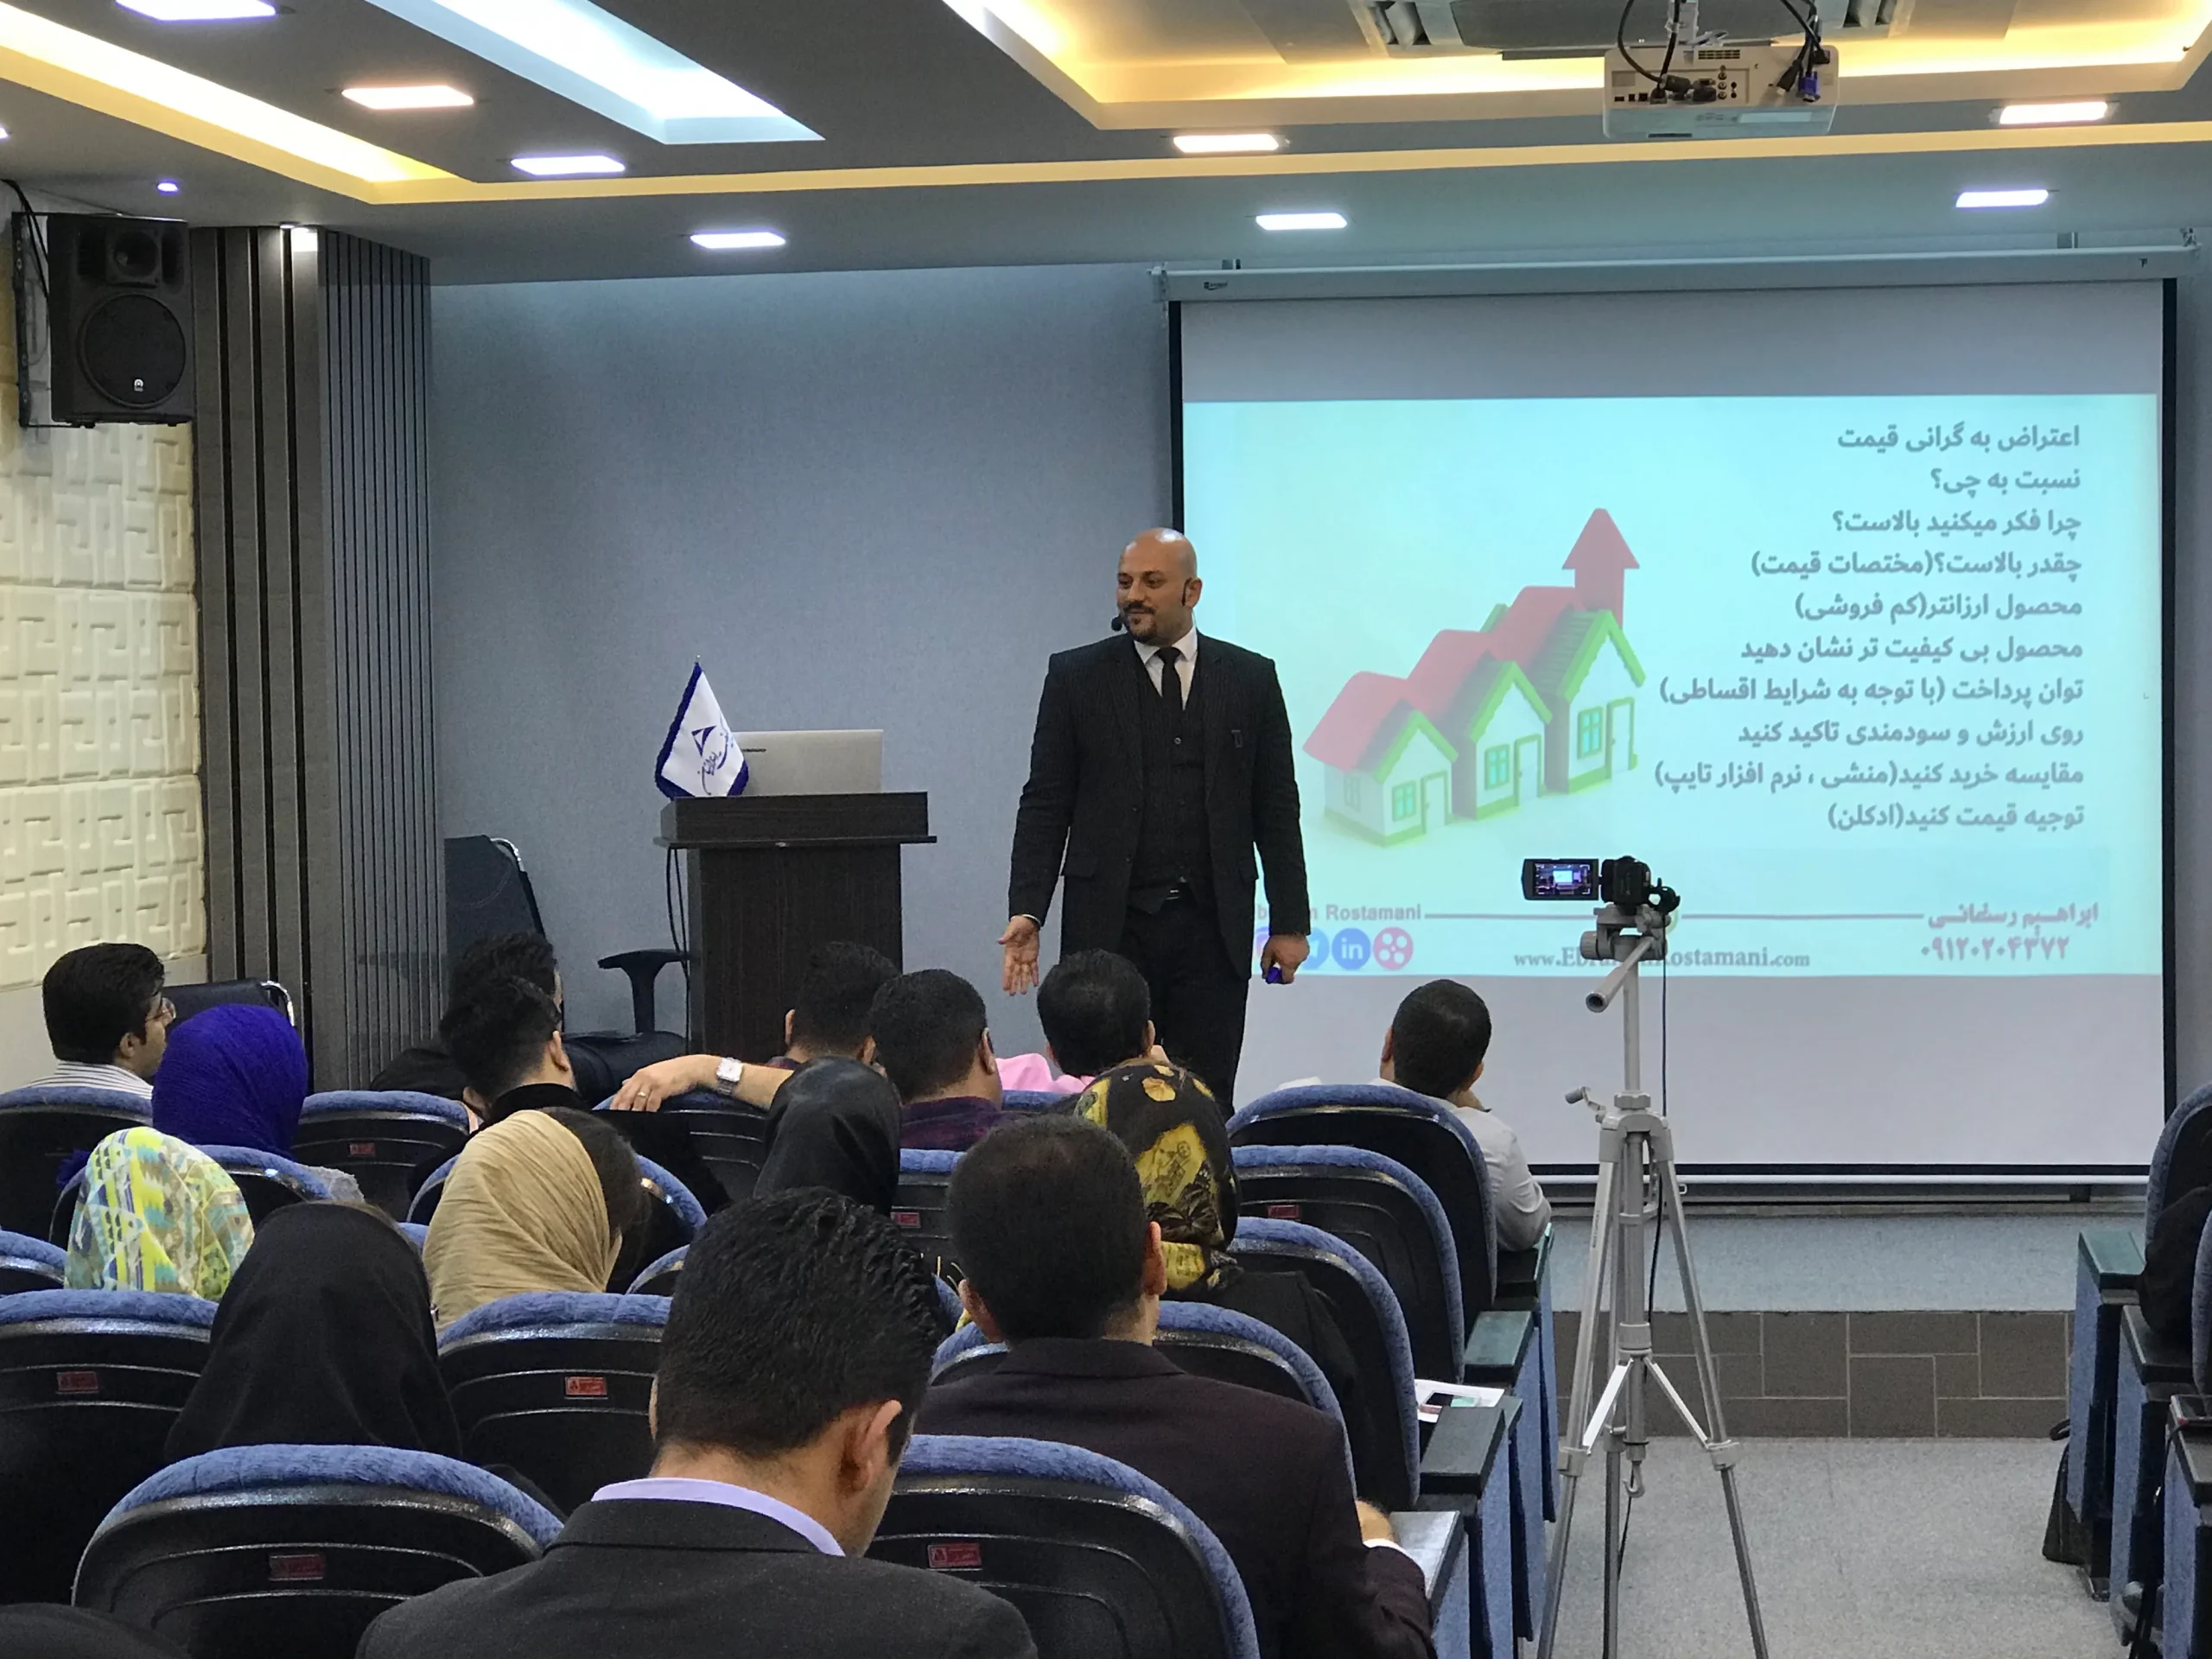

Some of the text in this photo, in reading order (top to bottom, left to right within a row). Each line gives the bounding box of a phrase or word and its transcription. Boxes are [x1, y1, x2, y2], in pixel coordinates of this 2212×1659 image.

[1837, 421, 2080, 454] اعتراض به گرانی قیمت
[1929, 467, 2082, 499] نسبت به چی؟
[1832, 507, 2082, 540] چرا فکر میکنید بالاست؟
[1751, 550, 1822, 581] قیمت)
[2026, 550, 2082, 583] چقدر
[1795, 591, 1885, 622] فروشی)
[1995, 592, 2083, 621] محصول
[1740, 634, 2083, 665] محصول بی کیفیت تر نشان دهید
[1659, 675, 2085, 709] توان پرداخت (با توجه به شرایط اقساطی)
[1738, 719, 2084, 749] روی ارزش و سودمندی تاکید کنید
[1654, 760, 1713, 795] تایپ)
[1715, 760, 1764, 790] افزار
[1770, 763, 1802, 794] نرم
[1948, 762, 1999, 791] خرید
[2005, 761, 2084, 791] مقایسه
[1955, 802, 2018, 833] قیمت
[2024, 804, 2085, 834] توجیه
[1325, 903, 1421, 921] Rostamani
